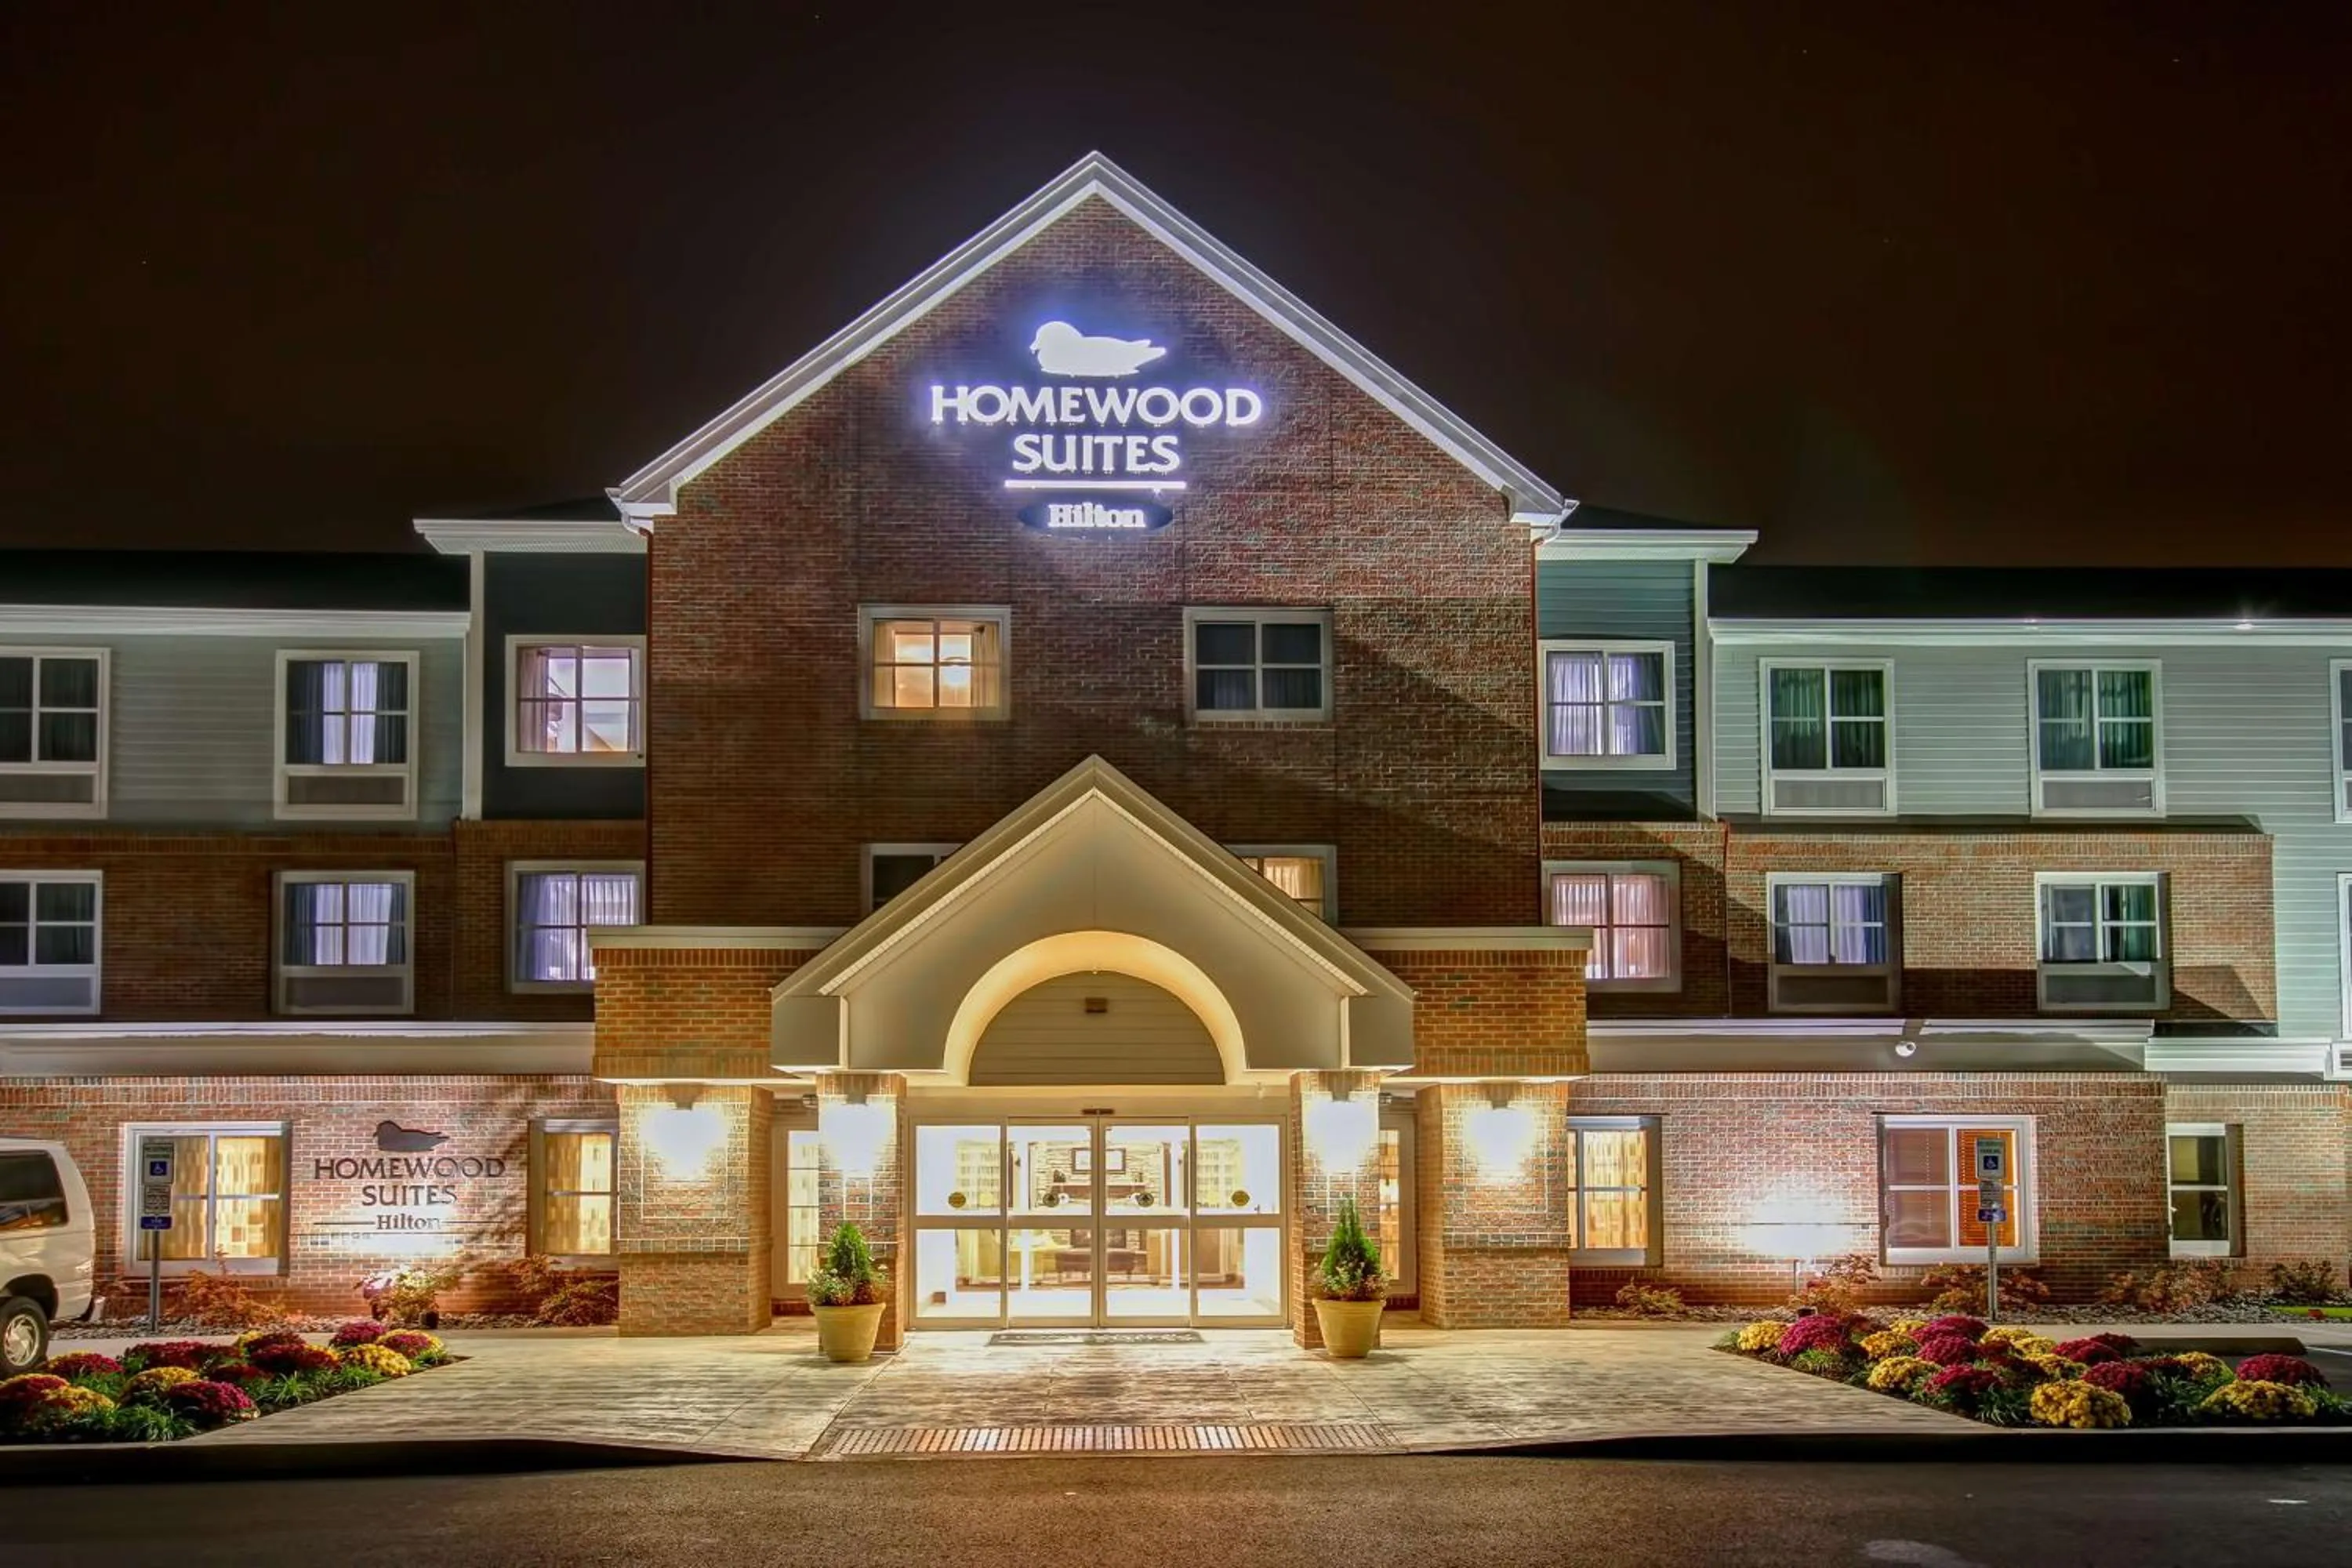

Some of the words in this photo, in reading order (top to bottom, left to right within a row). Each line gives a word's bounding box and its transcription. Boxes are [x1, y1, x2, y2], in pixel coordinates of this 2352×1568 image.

[931, 385, 1261, 425] HOMEWOOD
[1012, 434, 1181, 472] SUITES
[1048, 502, 1146, 528] Hilton
[314, 1157, 506, 1180] HOMEWOOD
[361, 1185, 458, 1207] SUITES
[376, 1213, 441, 1230] Hilton
